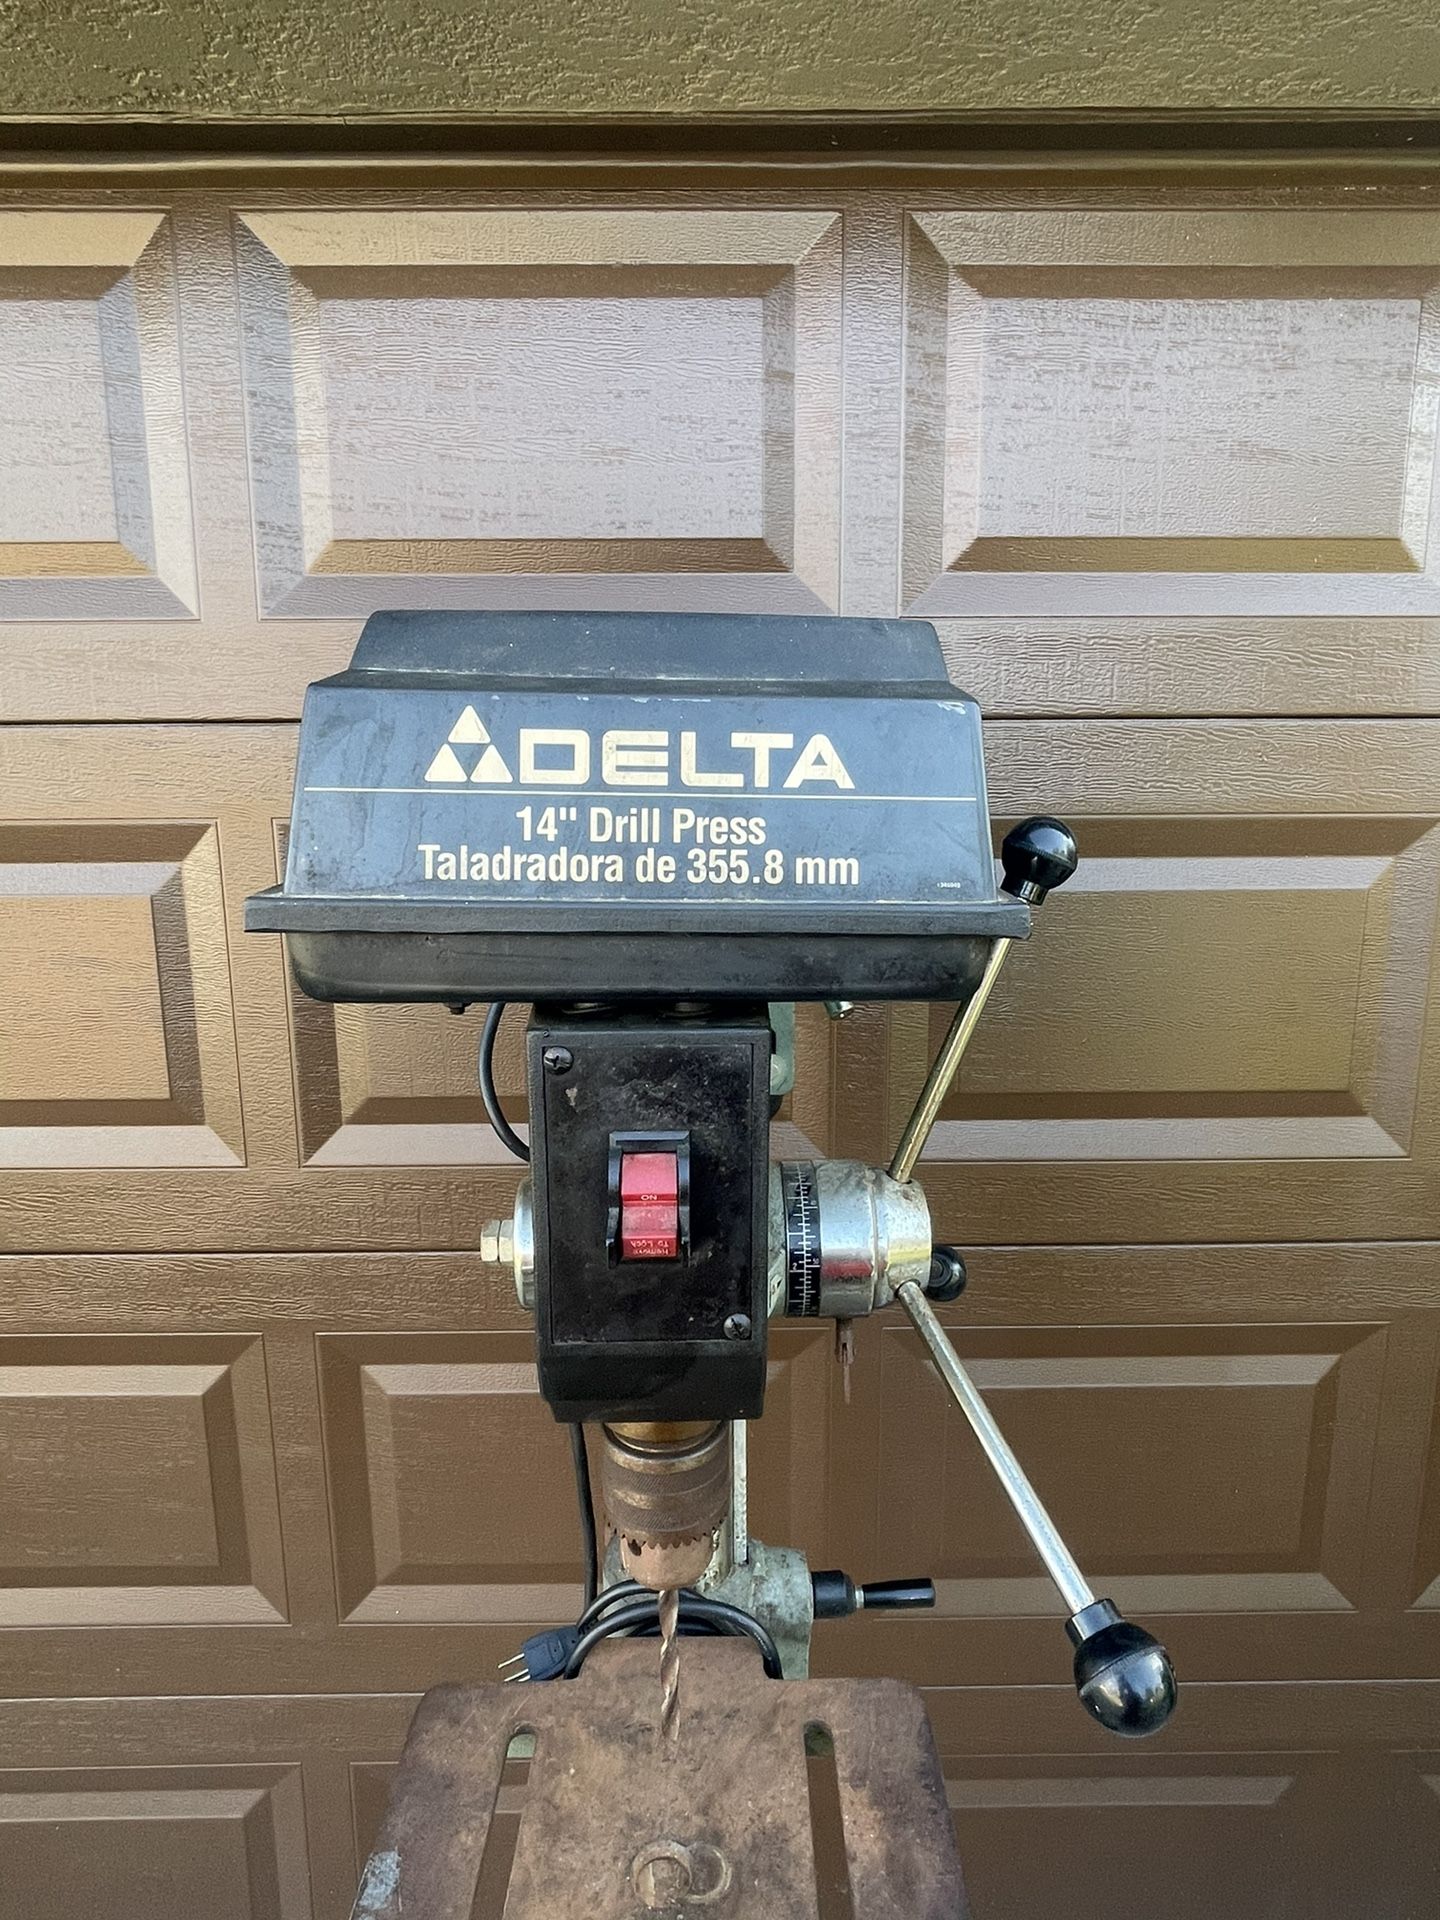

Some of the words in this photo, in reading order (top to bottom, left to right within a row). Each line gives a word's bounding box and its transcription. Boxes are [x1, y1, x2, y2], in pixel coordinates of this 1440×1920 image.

[519, 728, 856, 790] DELTA
[515, 805, 577, 842] 14"
[589, 806, 661, 843] Drill
[672, 807, 767, 845] Press
[417, 844, 624, 883] Taladradora
[635, 847, 676, 884] de
[686, 848, 784, 885] 355.8
[794, 855, 860, 886] mm
